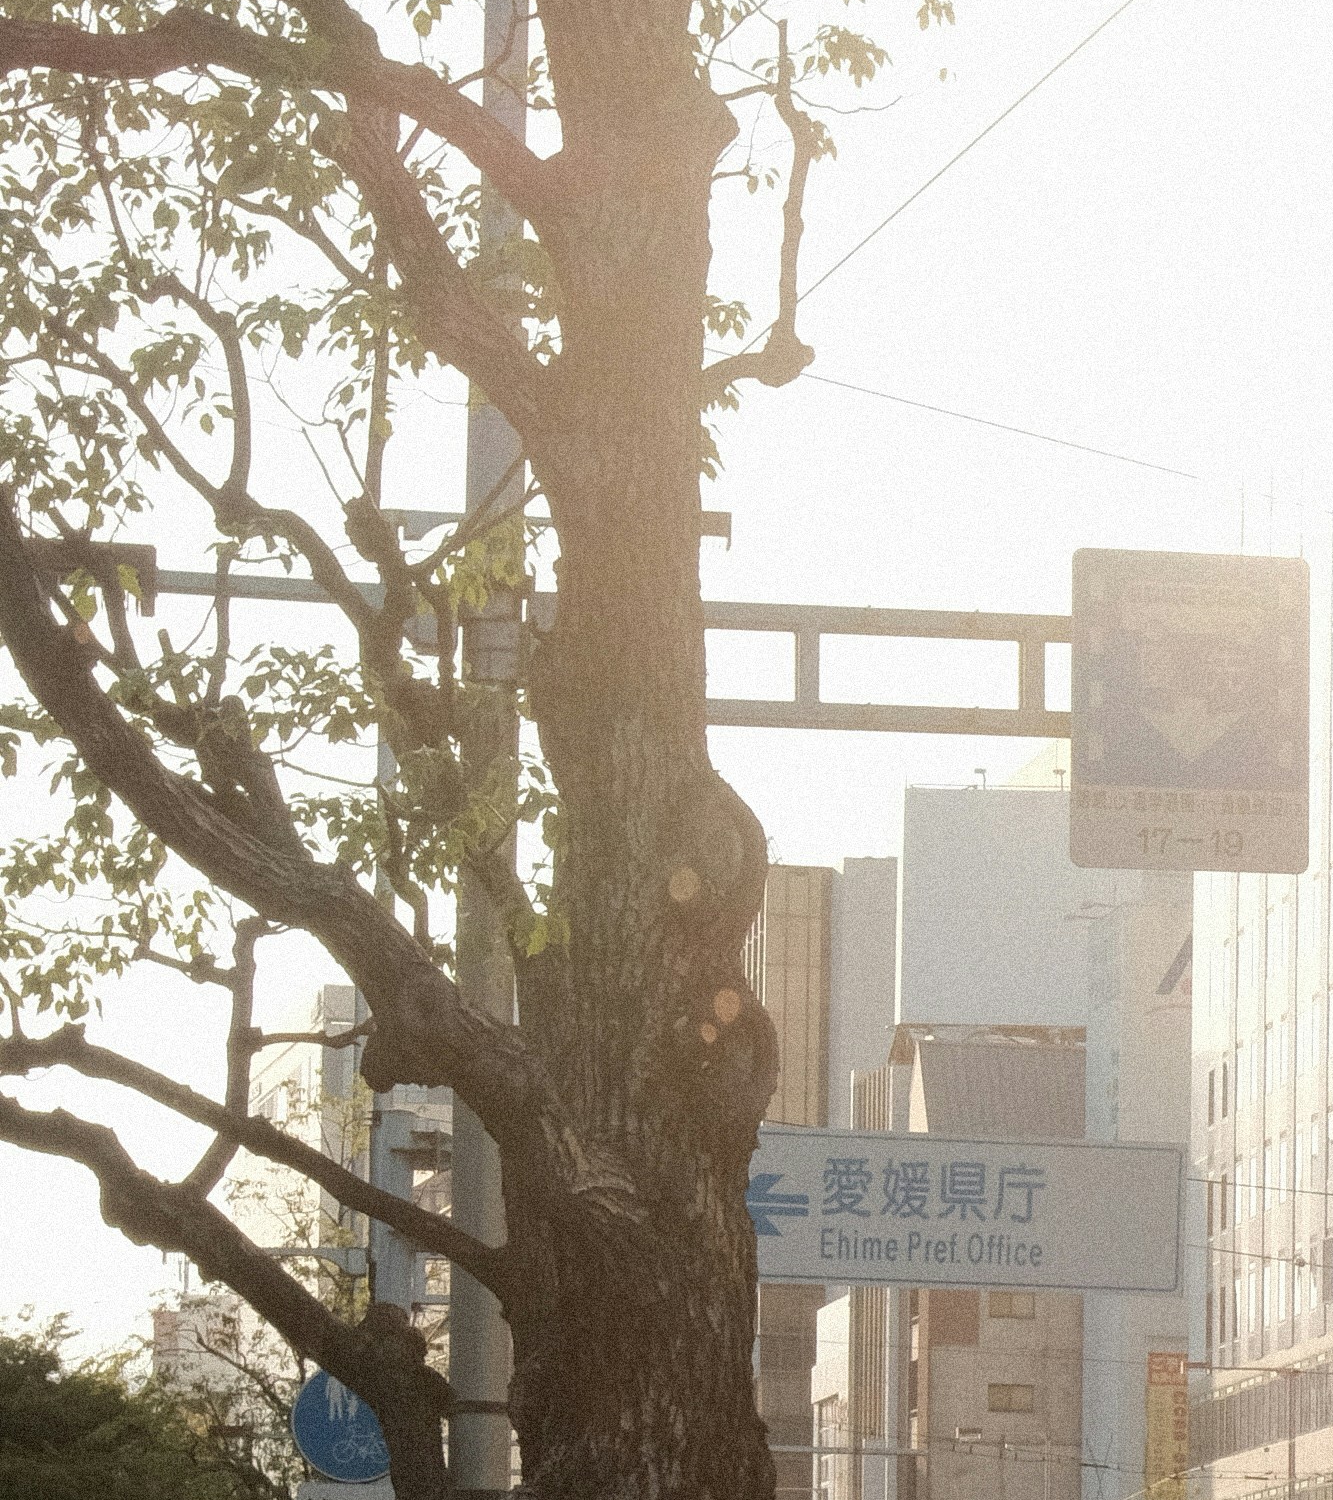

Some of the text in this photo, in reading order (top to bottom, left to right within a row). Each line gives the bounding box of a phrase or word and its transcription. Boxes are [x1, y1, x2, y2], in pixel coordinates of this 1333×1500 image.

[821, 1157, 1047, 1223] 愛媛県庁
[819, 1228, 1044, 1268] Ehime Pref. Office
